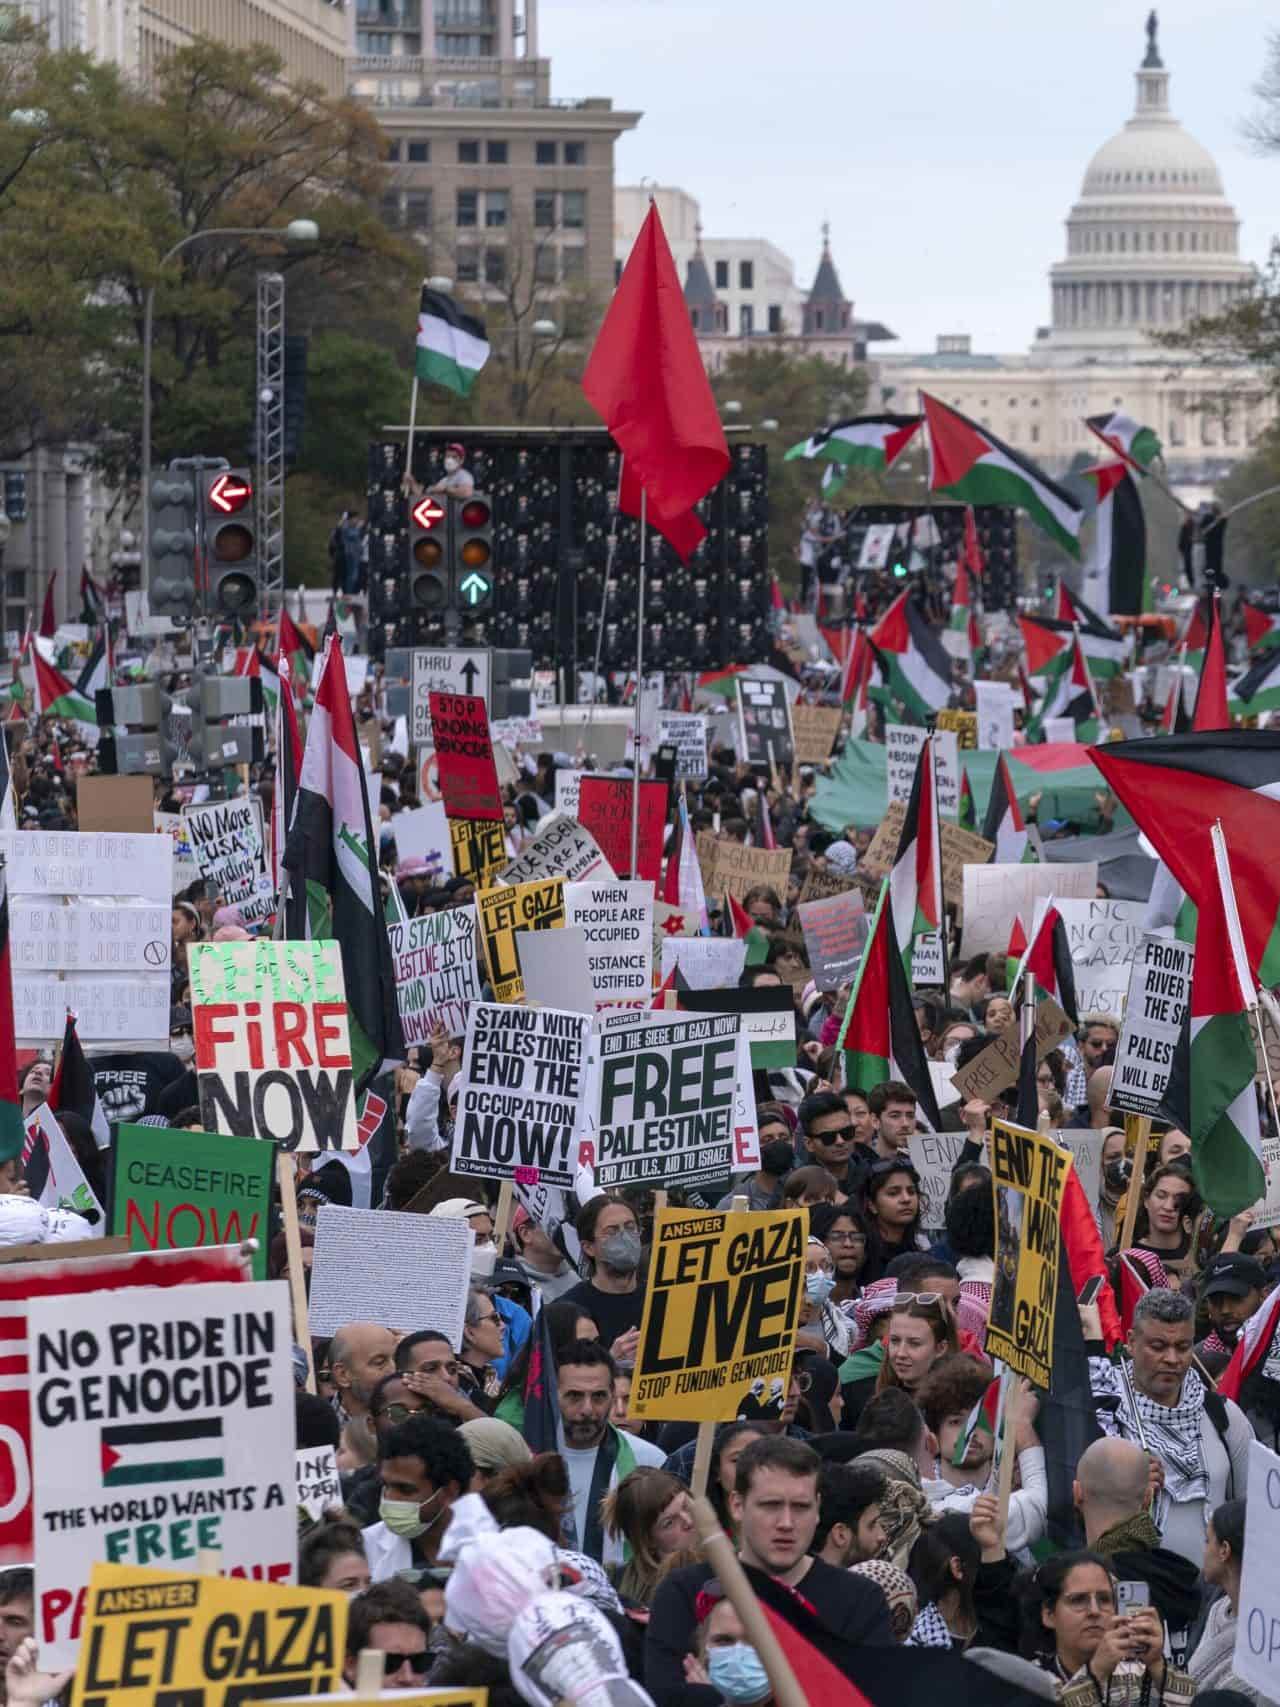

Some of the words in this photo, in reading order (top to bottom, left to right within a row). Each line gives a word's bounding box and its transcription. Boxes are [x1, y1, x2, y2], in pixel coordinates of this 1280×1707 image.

[416, 656, 452, 671] THRU
[439, 697, 477, 715] STOP
[188, 812, 214, 846] NO
[214, 807, 253, 838] More
[451, 823, 473, 844] LET
[204, 834, 246, 861] USA
[503, 854, 541, 884] JOE
[533, 815, 578, 857] BIDEN
[482, 889, 515, 908] ANSWER
[482, 901, 518, 935] LET
[521, 882, 565, 922] GAZA
[573, 909, 617, 924] PEOPLE
[620, 908, 646, 922] ARE
[591, 890, 628, 904] WHEN
[387, 924, 404, 954] TO
[408, 910, 451, 950] STAND
[441, 940, 456, 970] IS
[456, 934, 473, 962] TO
[588, 956, 646, 970] SISTANCE
[1144, 943, 1185, 973] FROM
[190, 940, 345, 1006] CEASE
[429, 964, 476, 1004] WITH
[592, 974, 645, 989] USTIFIED
[1144, 969, 1185, 999] RIVER
[474, 1006, 537, 1033] STAND
[542, 1014, 583, 1041] WITH
[608, 1014, 640, 1026] ANSWER
[1143, 996, 1168, 1022] THE
[472, 1030, 583, 1065] PALESTINE!
[604, 1036, 623, 1053] END
[625, 1031, 646, 1049] THE
[647, 1028, 671, 1046] SIEGE
[672, 1024, 687, 1041] ON
[687, 1020, 712, 1039] GAZA
[713, 1016, 738, 1035] NOW!
[1127, 1034, 1176, 1065] PALES
[93, 1070, 148, 1086] FREE
[469, 1052, 525, 1090] END
[533, 1060, 580, 1099] THE
[599, 1039, 737, 1126] FREE
[1121, 1065, 1148, 1089] WILL
[1152, 1073, 1168, 1094] BE
[199, 1068, 356, 1152] NOW
[464, 1091, 576, 1127] OCCUPATION
[460, 1113, 572, 1172] NOW!
[598, 1109, 731, 1162] PALESTINE!
[599, 1166, 618, 1184] END
[619, 1161, 639, 1181] ALL
[641, 1158, 661, 1176] U.S.
[663, 1155, 681, 1173] AID
[683, 1153, 695, 1169] TO
[698, 1146, 729, 1166] ISRAEL
[993, 1127, 1036, 1189] END
[126, 1159, 263, 1199] CEASEFIRE
[126, 1198, 260, 1253] NOW
[662, 1218, 723, 1240] ANSWER
[1025, 1198, 1058, 1266] WAR
[654, 1238, 721, 1290] LET
[726, 1218, 804, 1277] GAZA
[640, 1261, 801, 1376] LIVE!
[1015, 1298, 1051, 1366] GAZA
[37, 1328, 99, 1374] NO
[109, 1318, 225, 1366] PRIDE
[233, 1311, 276, 1357] IN
[36, 1358, 273, 1427] GENOCIDE
[637, 1376, 671, 1401] STOP
[675, 1369, 727, 1394] FUNDING
[730, 1349, 792, 1384] GENOCIDE!
[43, 1507, 86, 1532] THE
[89, 1496, 171, 1525] WORLD
[173, 1485, 253, 1517] WANTS
[263, 1483, 285, 1510] A
[105, 1516, 223, 1563] FREE
[99, 1584, 197, 1613] ANSWER
[84, 1617, 191, 1692] LET
[200, 1603, 334, 1682] GAZA
